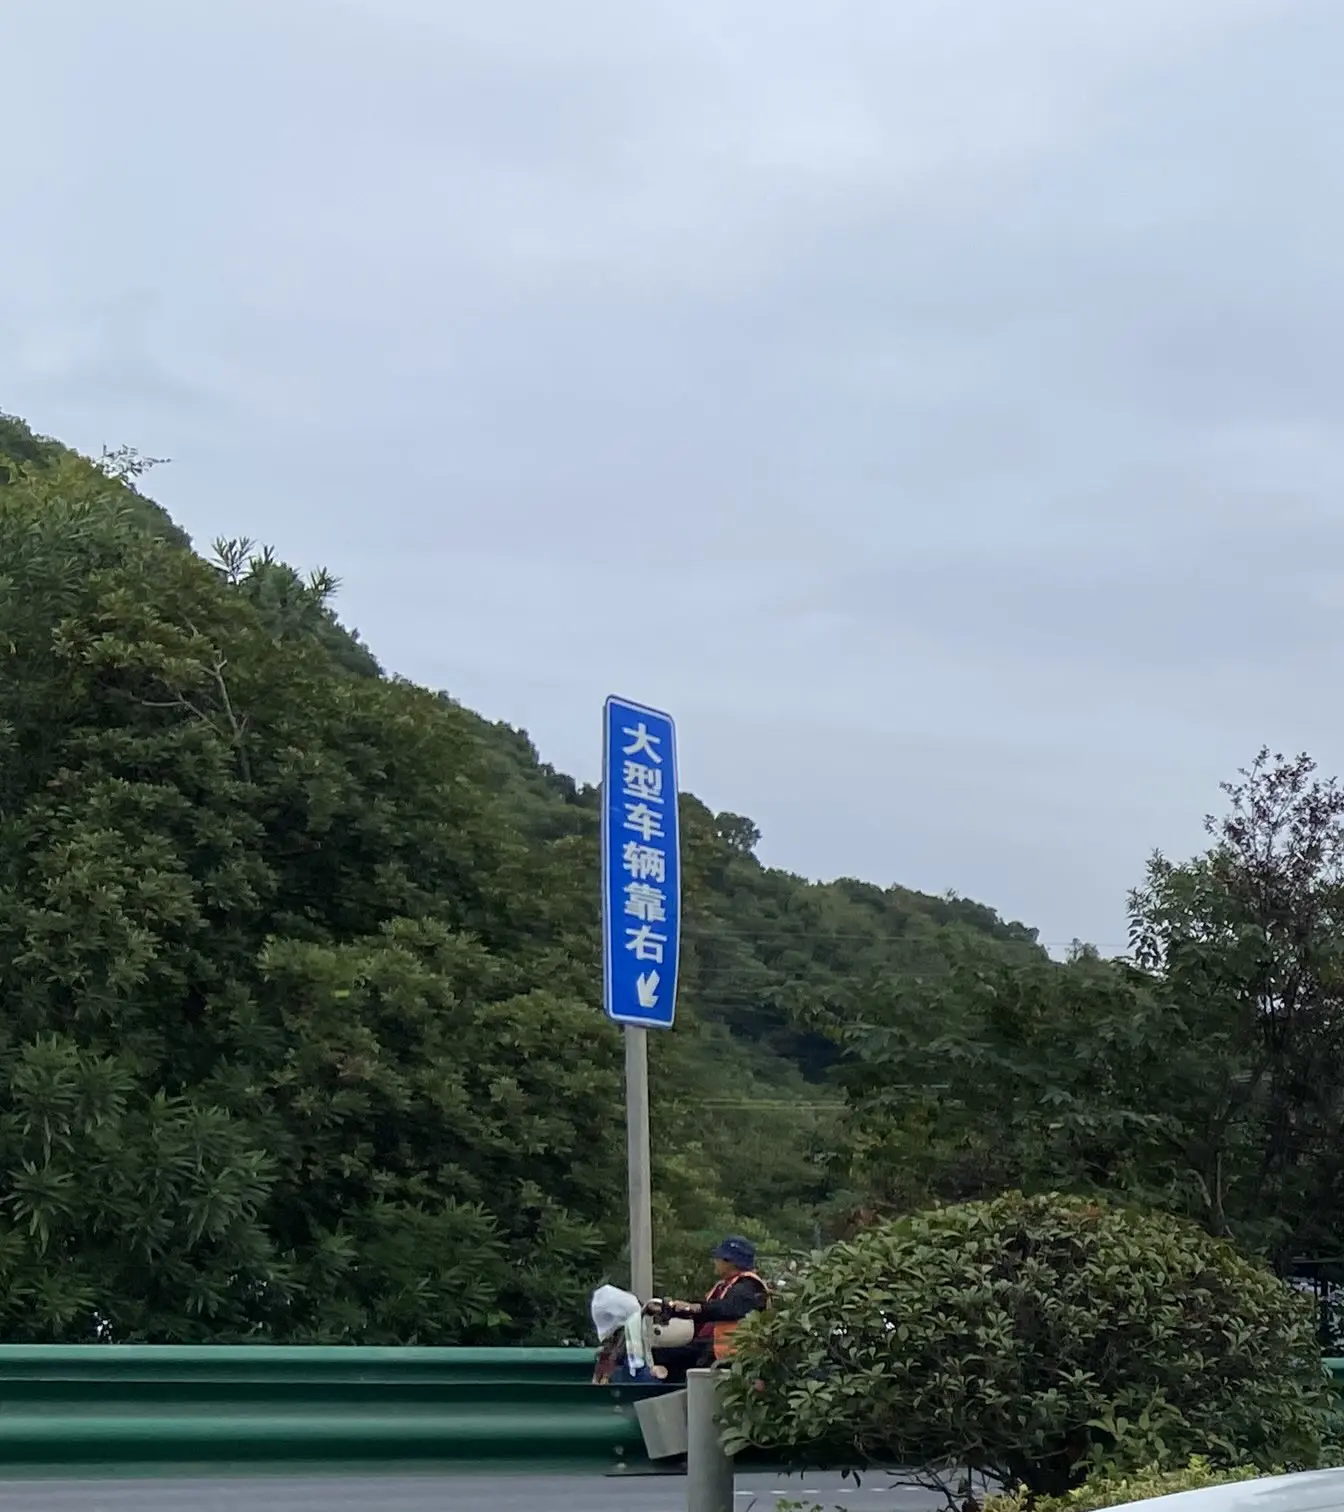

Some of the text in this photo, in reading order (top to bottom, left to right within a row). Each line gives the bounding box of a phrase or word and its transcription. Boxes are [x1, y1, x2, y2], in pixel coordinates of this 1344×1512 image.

[622, 722, 668, 965] 大型车辆靠右
